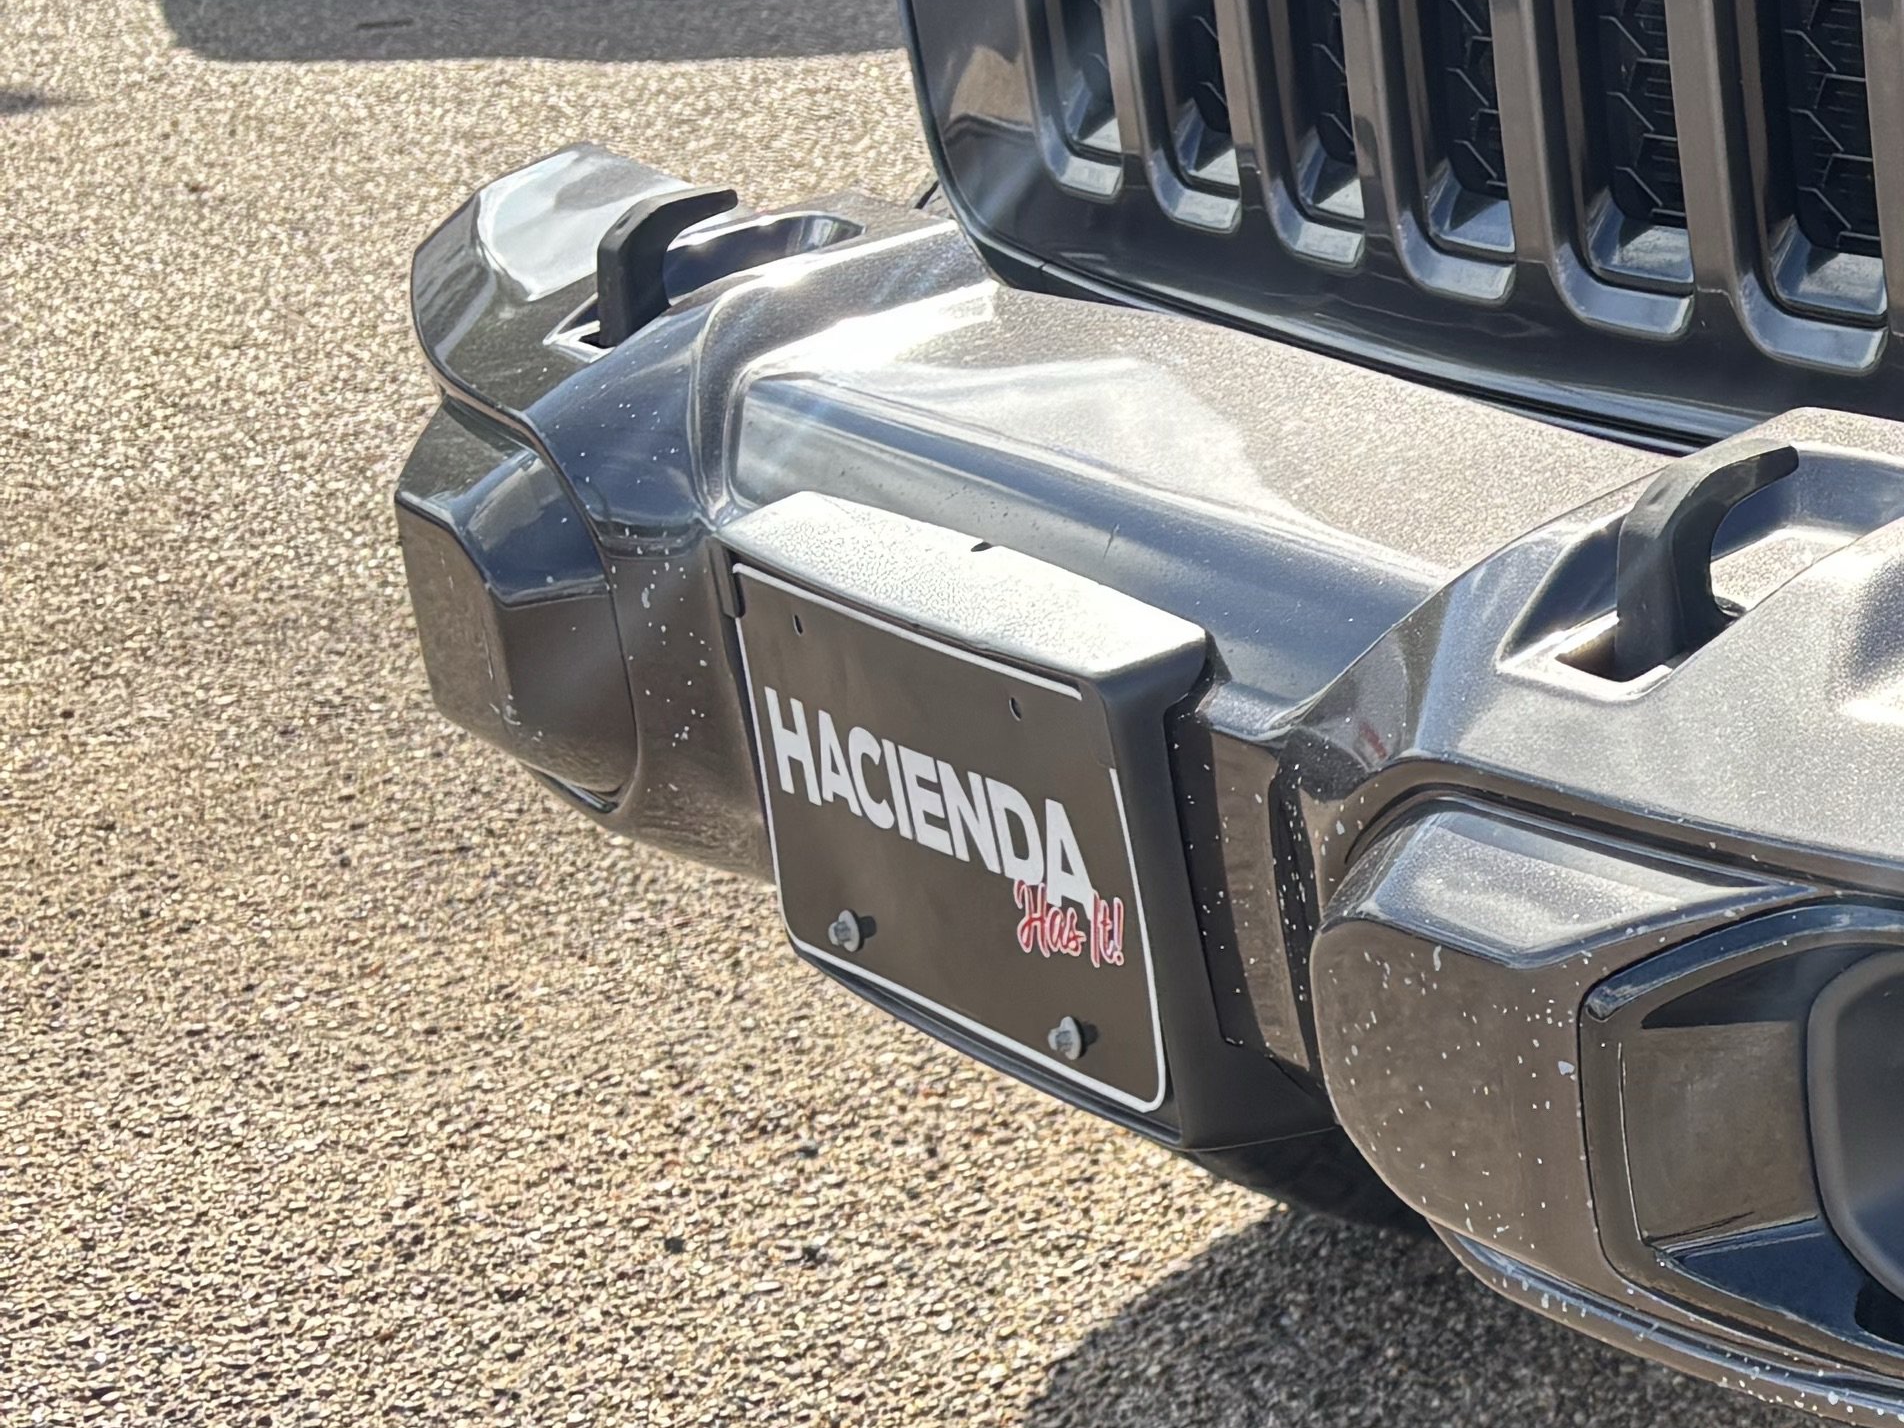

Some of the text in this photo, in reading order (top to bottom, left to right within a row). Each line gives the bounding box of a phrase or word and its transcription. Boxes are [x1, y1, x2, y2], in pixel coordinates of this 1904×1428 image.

[764, 686, 1096, 918] HACIENDA
[1015, 880, 1126, 968] Has It!
